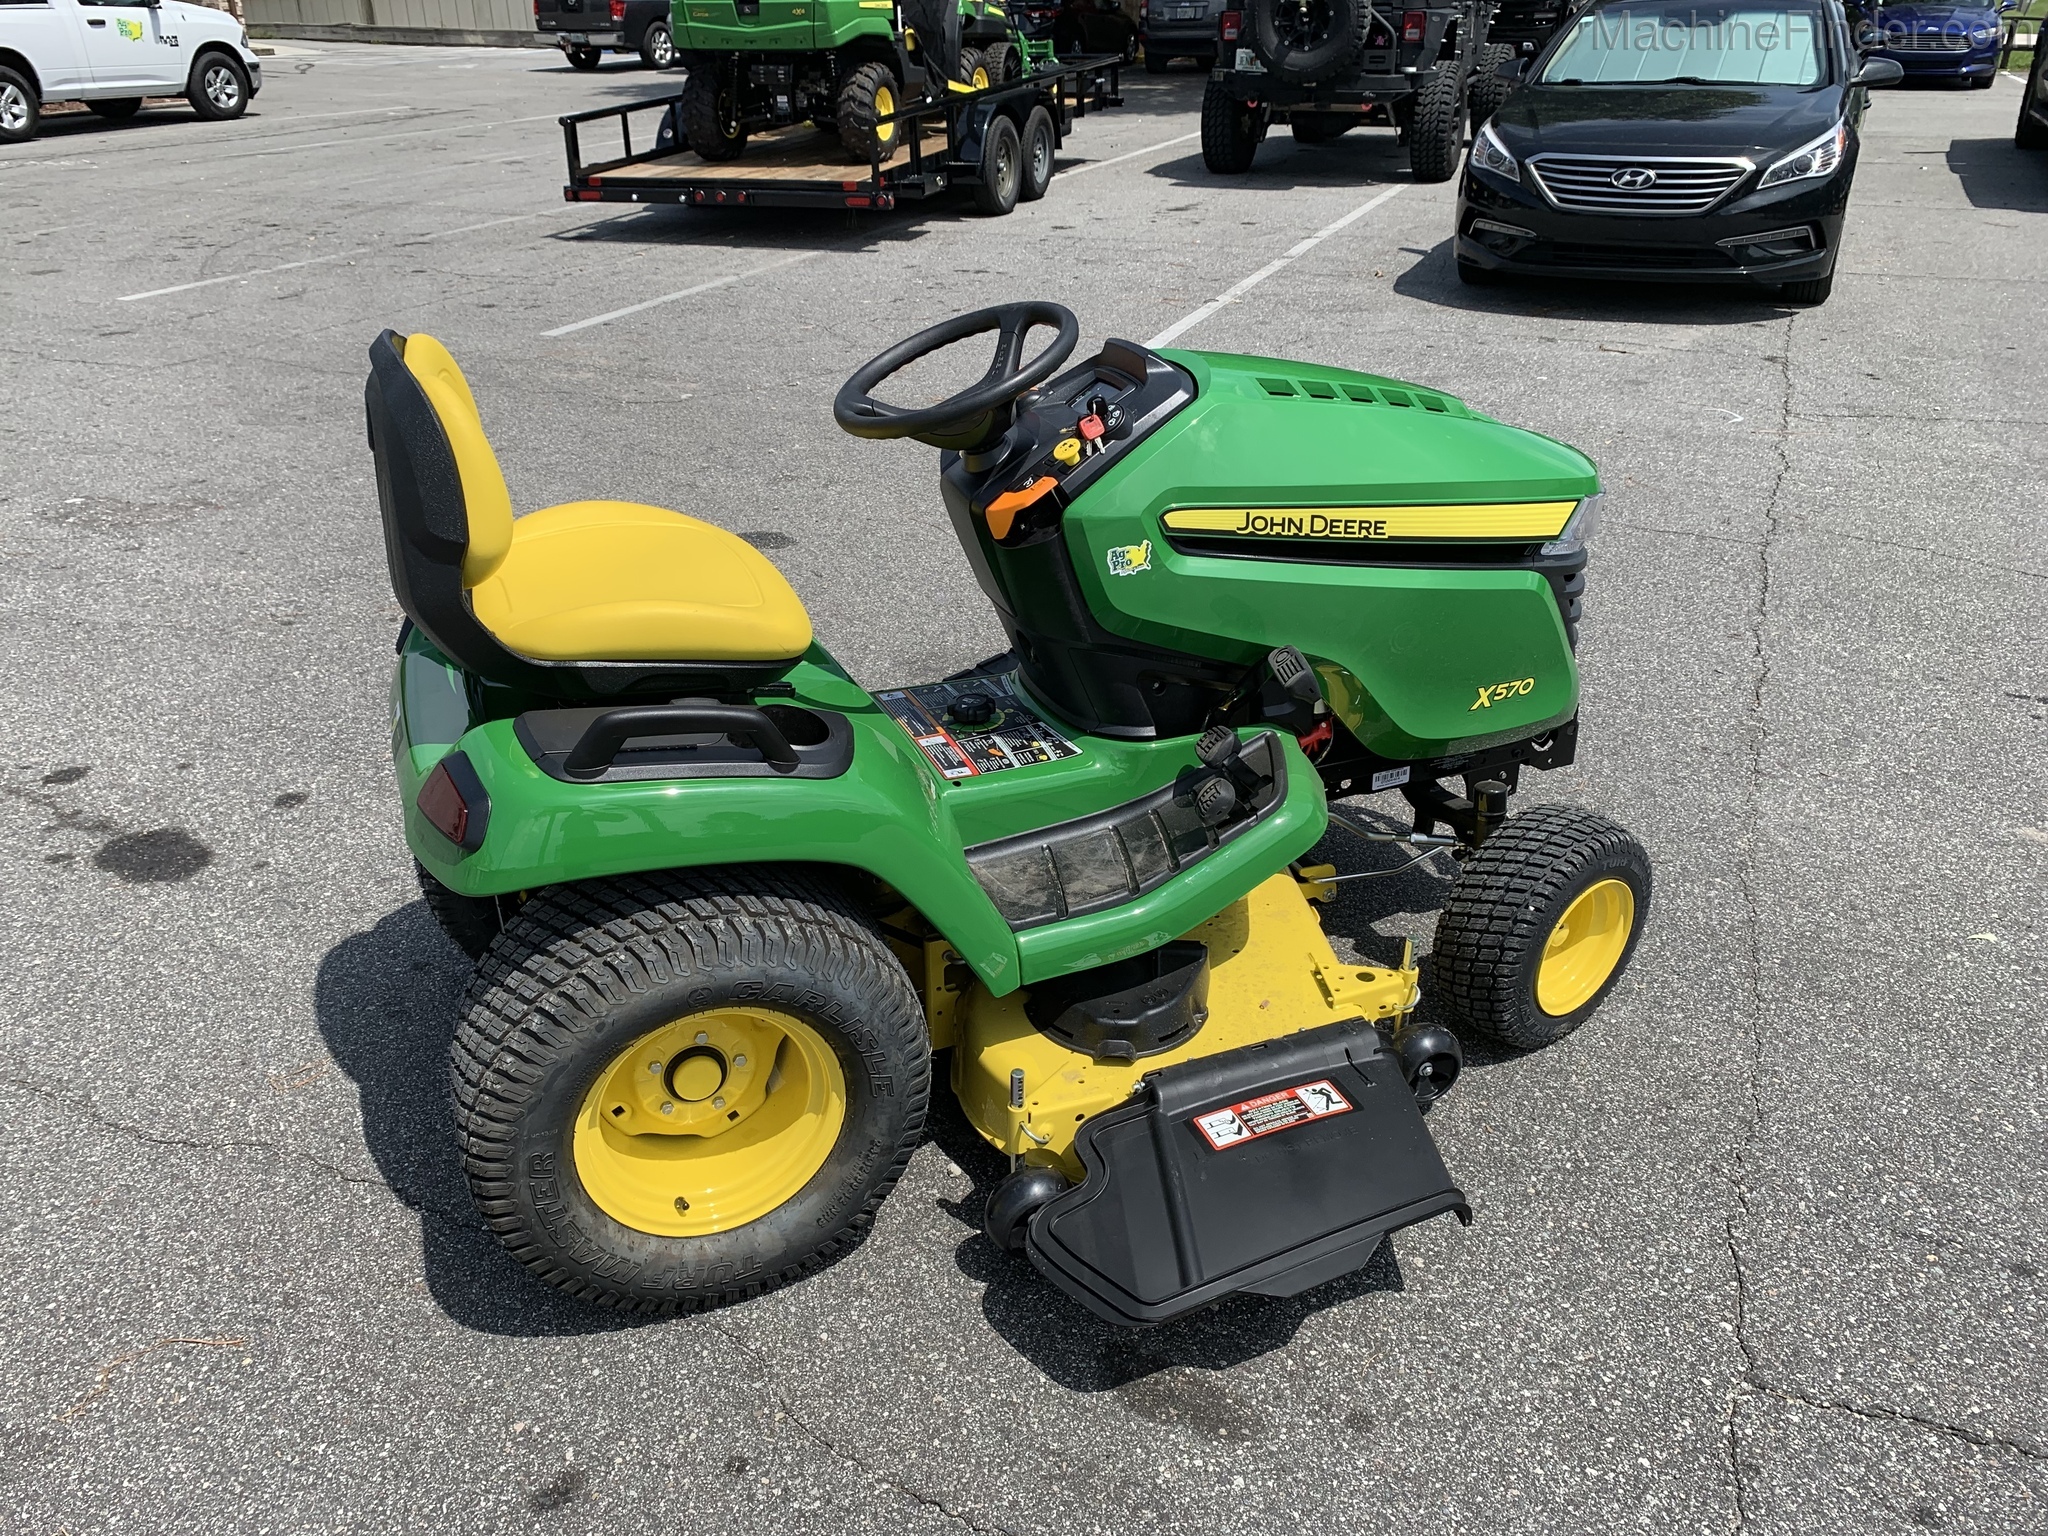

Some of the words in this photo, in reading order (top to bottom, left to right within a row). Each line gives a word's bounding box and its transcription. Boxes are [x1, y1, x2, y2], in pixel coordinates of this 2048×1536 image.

[1236, 511, 1304, 534] JOHN
[1309, 514, 1388, 537] DEERE
[1110, 549, 1130, 562] Ag-
[1111, 559, 1132, 571] Pro
[1467, 677, 1535, 711] X570
[728, 979, 896, 1100] CARLISLE
[1250, 1092, 1290, 1108] DANGER
[528, 1151, 642, 1286] MASTER
[641, 1253, 763, 1291] TURF
